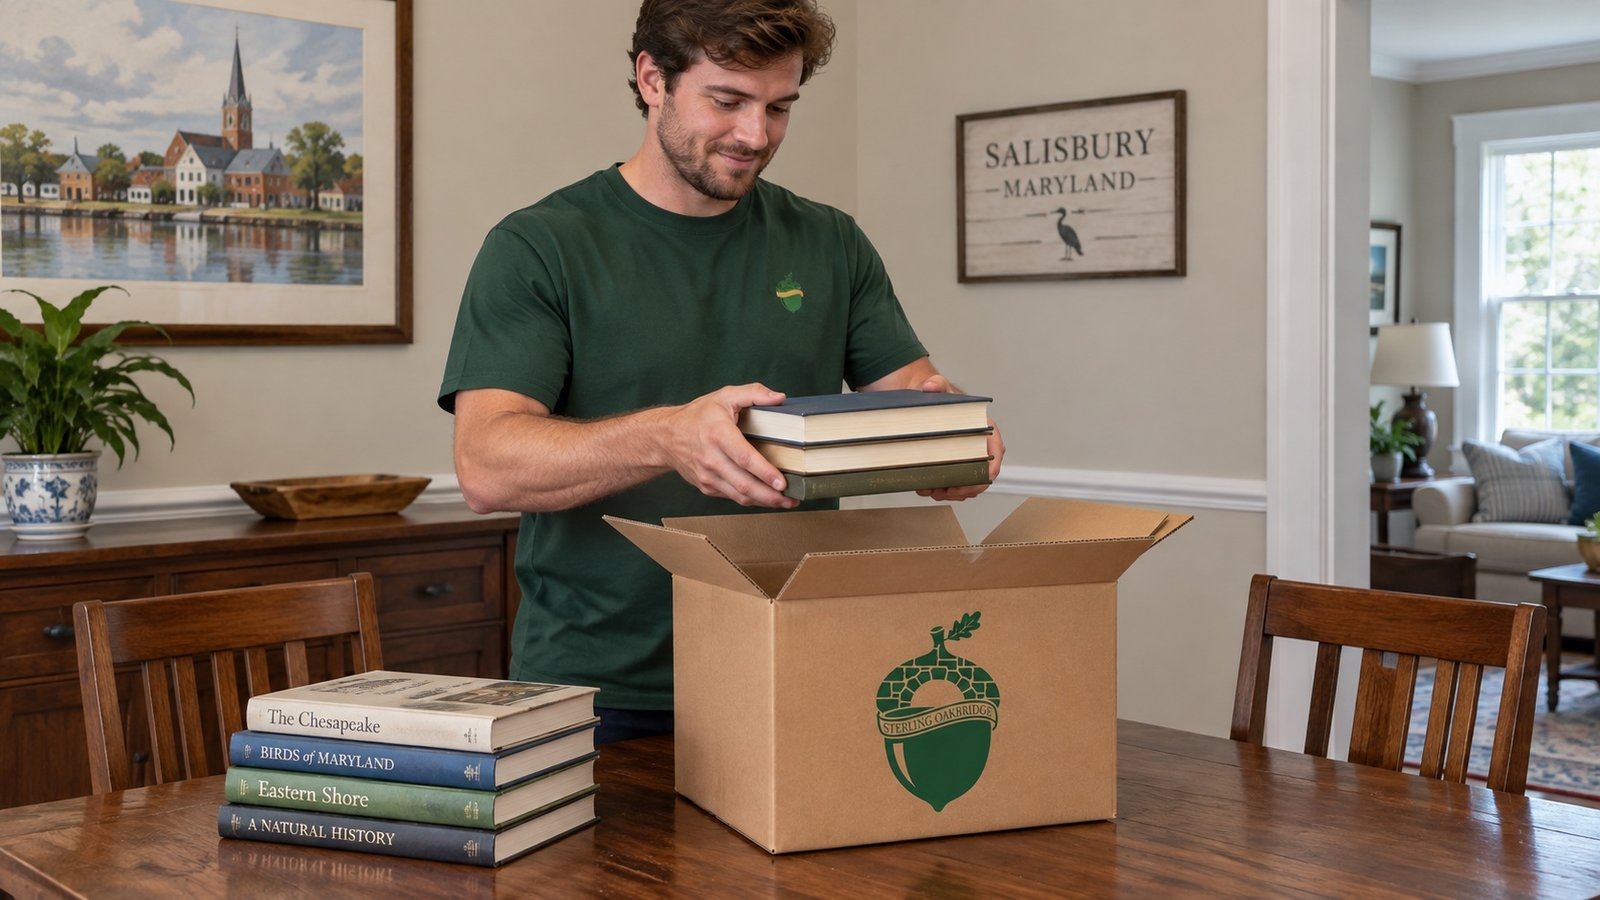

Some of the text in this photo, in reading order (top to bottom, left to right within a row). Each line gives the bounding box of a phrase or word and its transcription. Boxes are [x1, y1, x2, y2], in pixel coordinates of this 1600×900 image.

[985, 128, 1155, 169] SALISBURY
[1004, 171, 1136, 198] MARYLAND
[267, 709, 381, 735] The Chesapeake
[883, 704, 993, 734] STERLING OAKBRIDGE
[260, 746, 395, 771] BIRDS of MARYLAND
[258, 780, 369, 808] Eastern Shore
[248, 818, 395, 846] A NATURAL HISTORY
